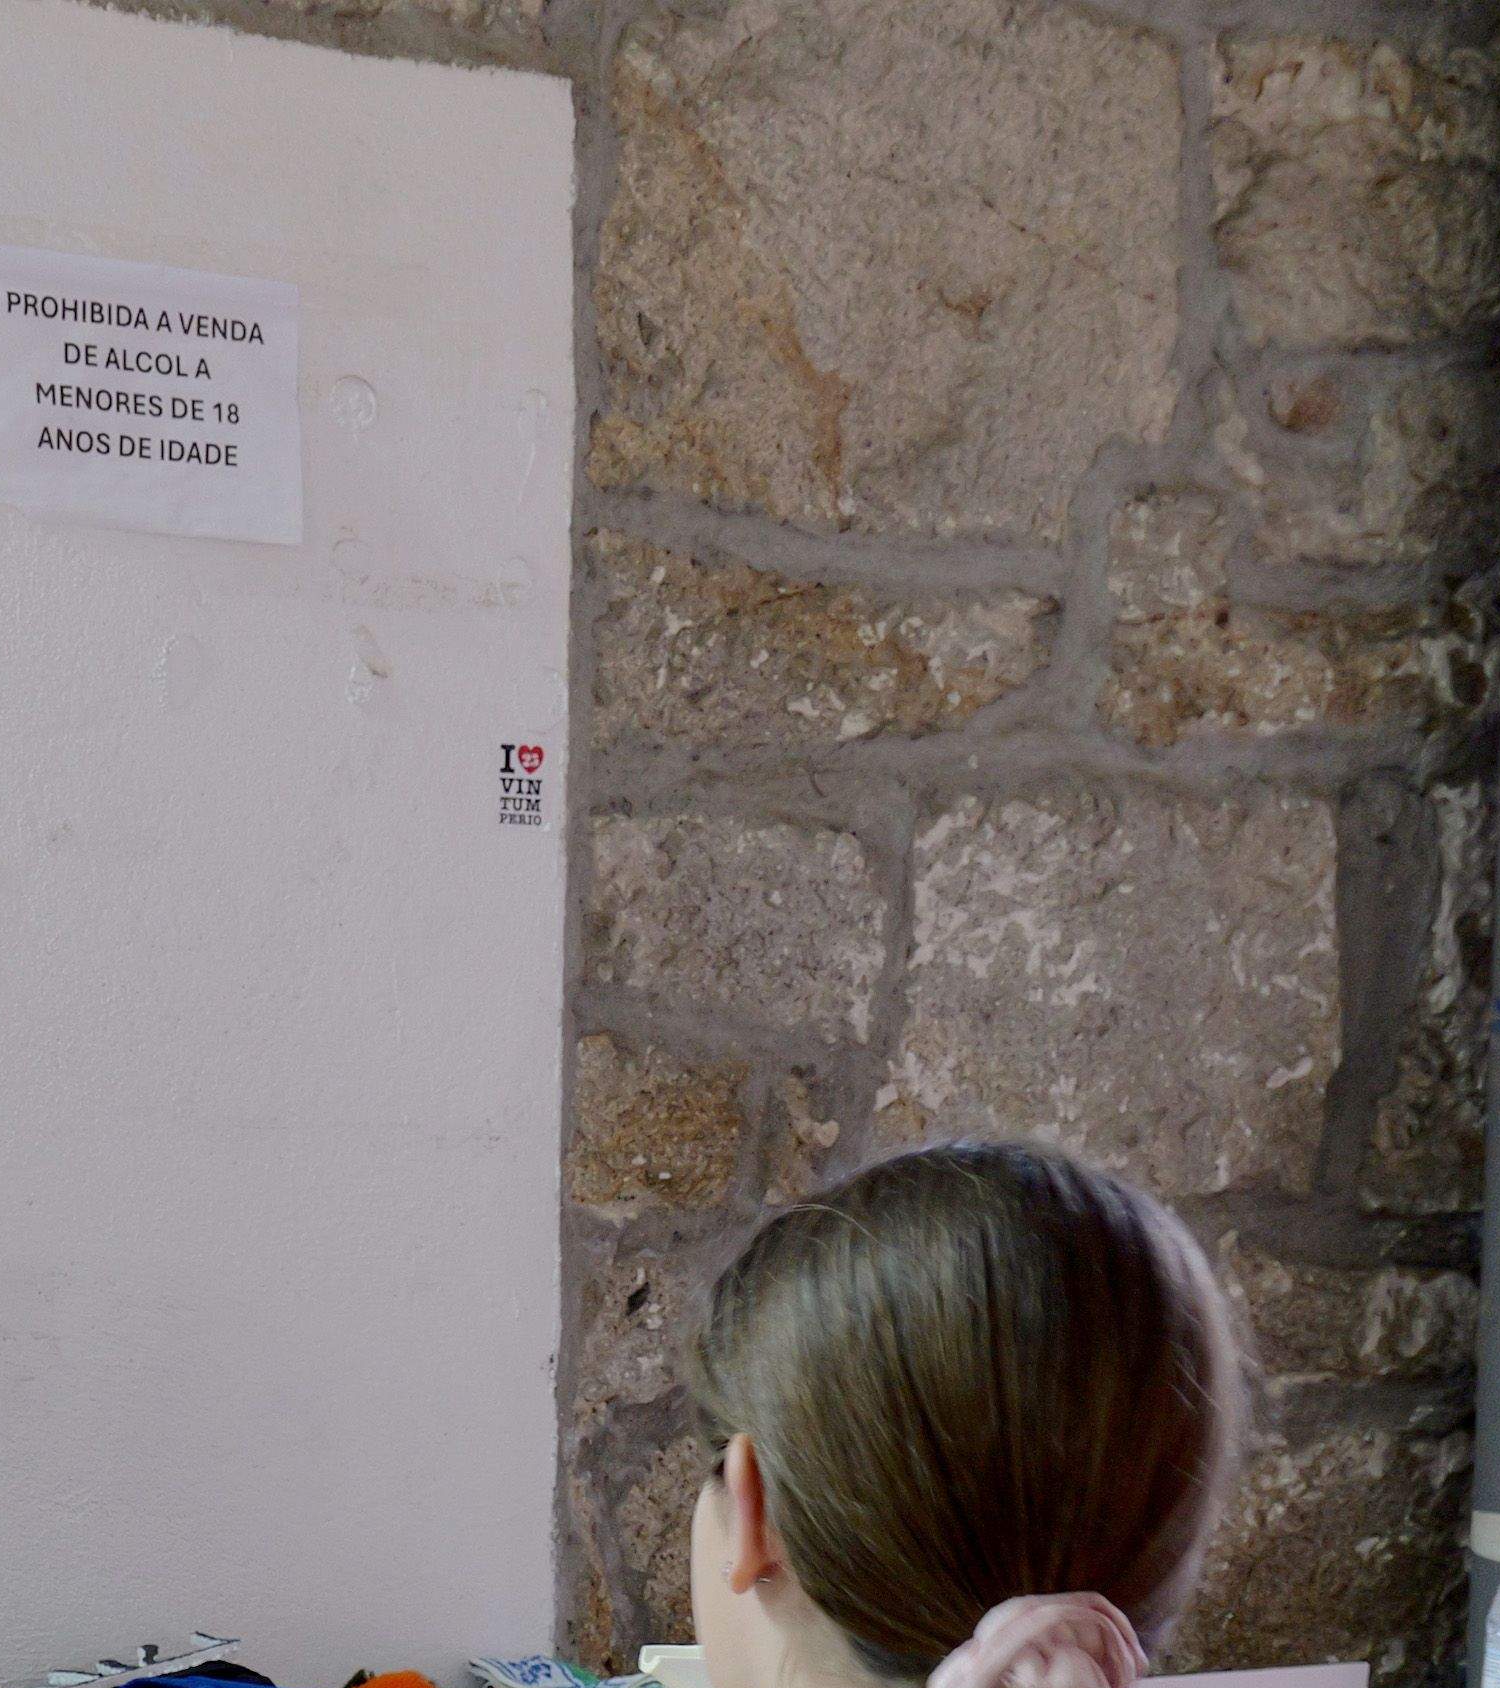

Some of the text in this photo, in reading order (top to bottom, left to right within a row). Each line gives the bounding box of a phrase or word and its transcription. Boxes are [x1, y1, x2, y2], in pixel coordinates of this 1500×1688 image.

[6, 291, 265, 345] PROHIBIDA A VENDA
[64, 342, 212, 380] DE ALCOL A
[36, 382, 240, 425] MENORES DE 18
[37, 426, 239, 467] ANOS DE IDADE
[500, 744, 516, 773] I
[500, 778, 542, 795] VIN
[500, 797, 541, 812] TUM
